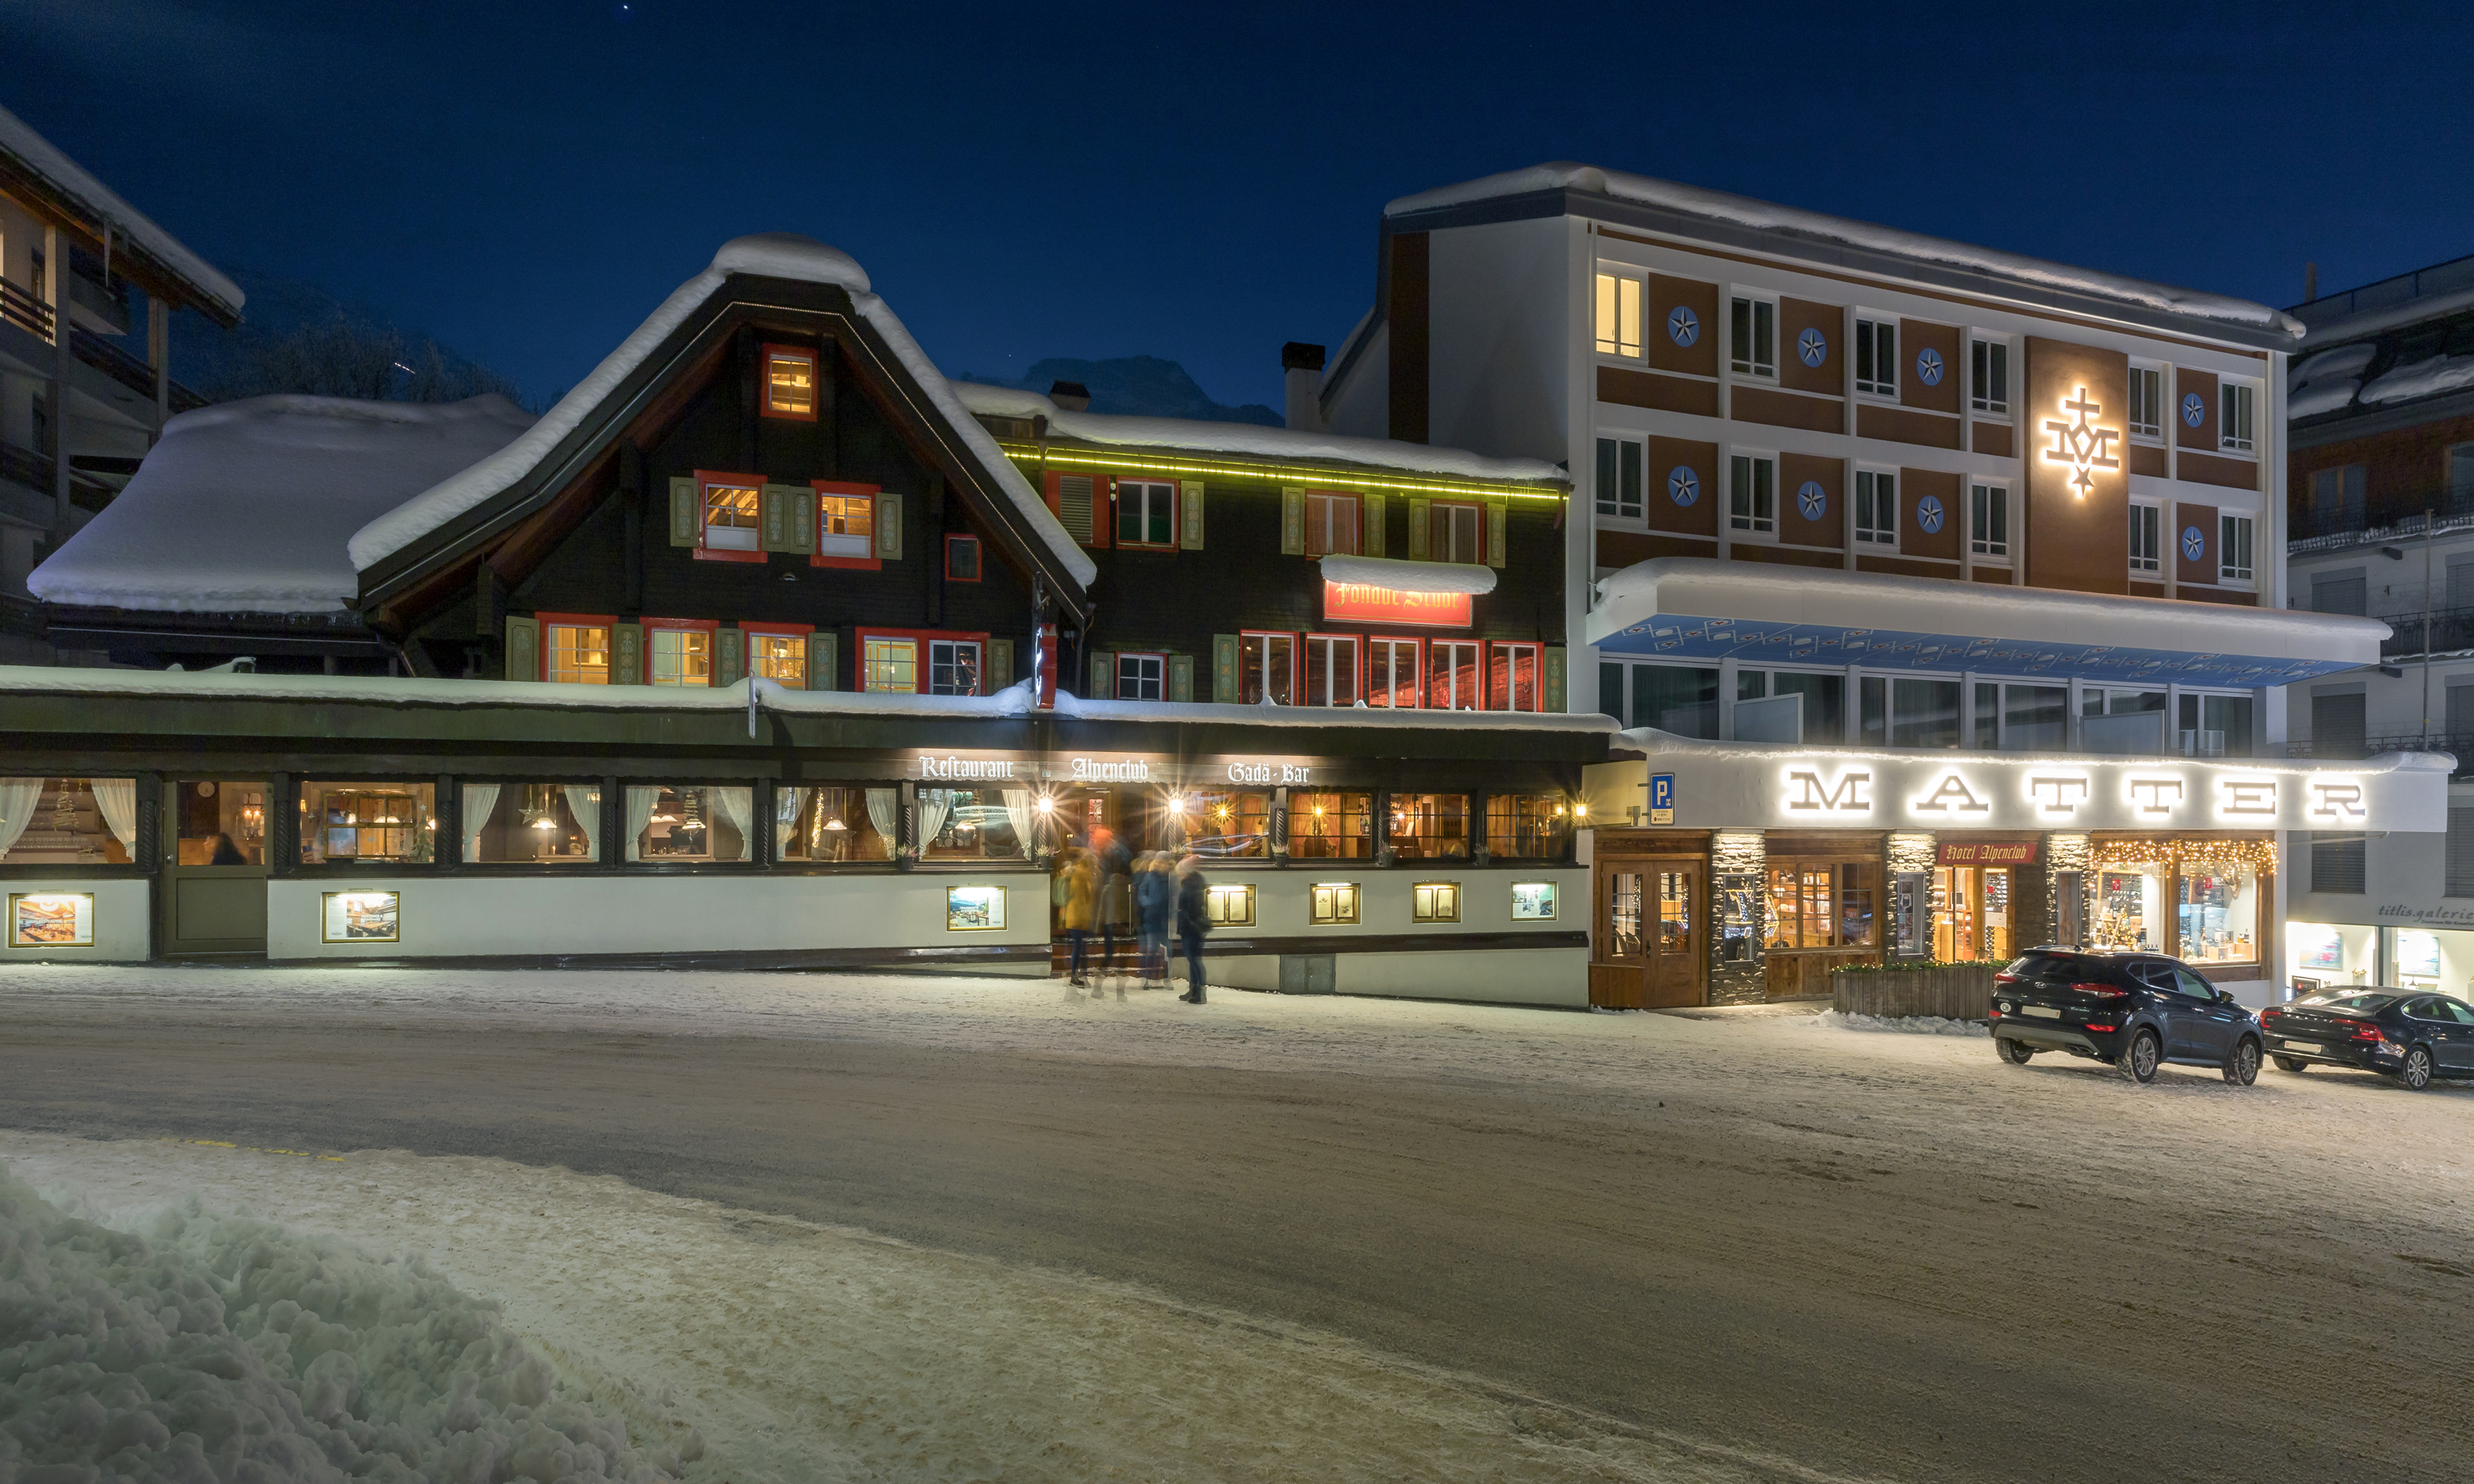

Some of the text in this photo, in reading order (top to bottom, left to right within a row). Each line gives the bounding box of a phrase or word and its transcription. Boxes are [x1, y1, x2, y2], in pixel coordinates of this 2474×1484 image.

[1334, 582, 1400, 608] Fondue
[919, 755, 1015, 779] Restaurant
[1071, 758, 1149, 782] Alpenclub
[1280, 763, 1310, 784] Bar
[1657, 781, 1667, 805] P
[1790, 771, 2366, 816] MATTER
[1946, 844, 2027, 862] Hotel Alpenclub
[2378, 904, 2474, 923] titlis.galerie
